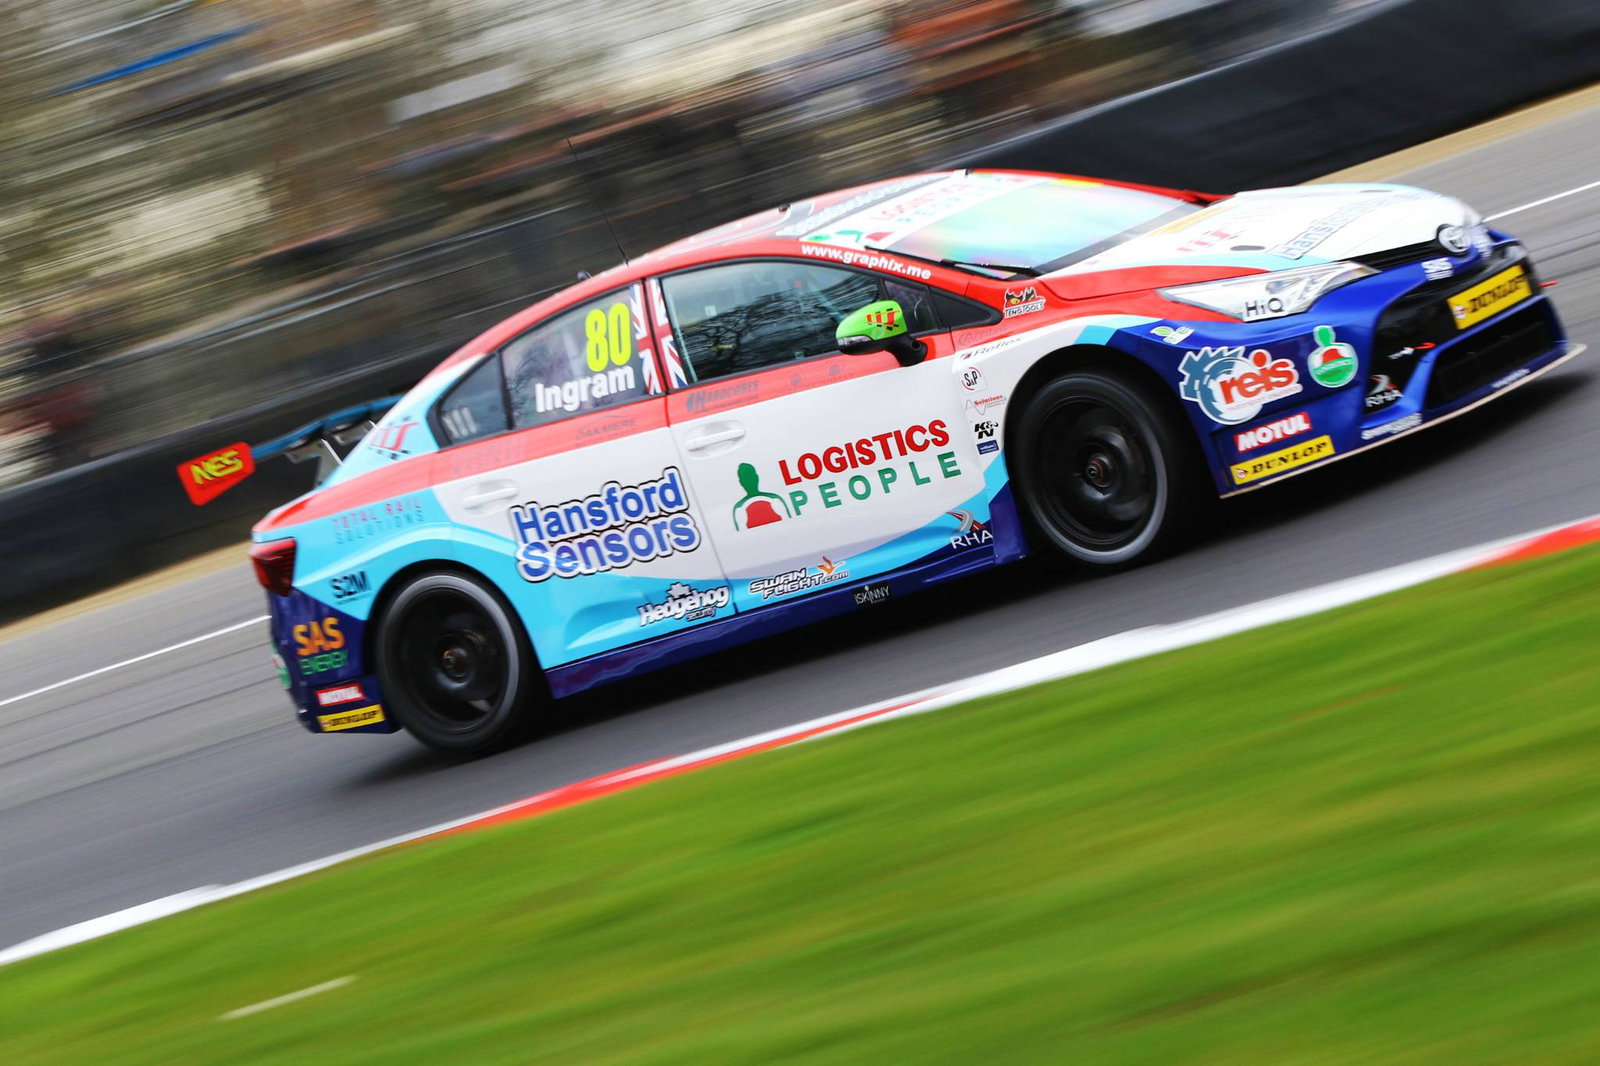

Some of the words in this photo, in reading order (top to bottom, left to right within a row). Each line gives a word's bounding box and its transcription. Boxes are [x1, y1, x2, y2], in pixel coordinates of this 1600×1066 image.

[801, 243, 932, 280] www.graphix.me
[1245, 297, 1284, 317] HiQ
[585, 302, 632, 372] 80
[535, 365, 636, 413] Ingram
[1219, 351, 1296, 404] reis
[1365, 389, 1403, 407] RHA
[778, 419, 950, 486] LOGISTICS
[1237, 414, 1311, 451] MOTUL
[1251, 441, 1328, 474] DUNLOP
[789, 451, 962, 517] PEOPLE
[514, 472, 684, 544] Hansford
[521, 516, 697, 578] Sensors
[950, 530, 994, 550] RHA
[750, 567, 807, 594] SWAN
[637, 586, 730, 627] Hedgehog
[293, 617, 346, 656] SAS
